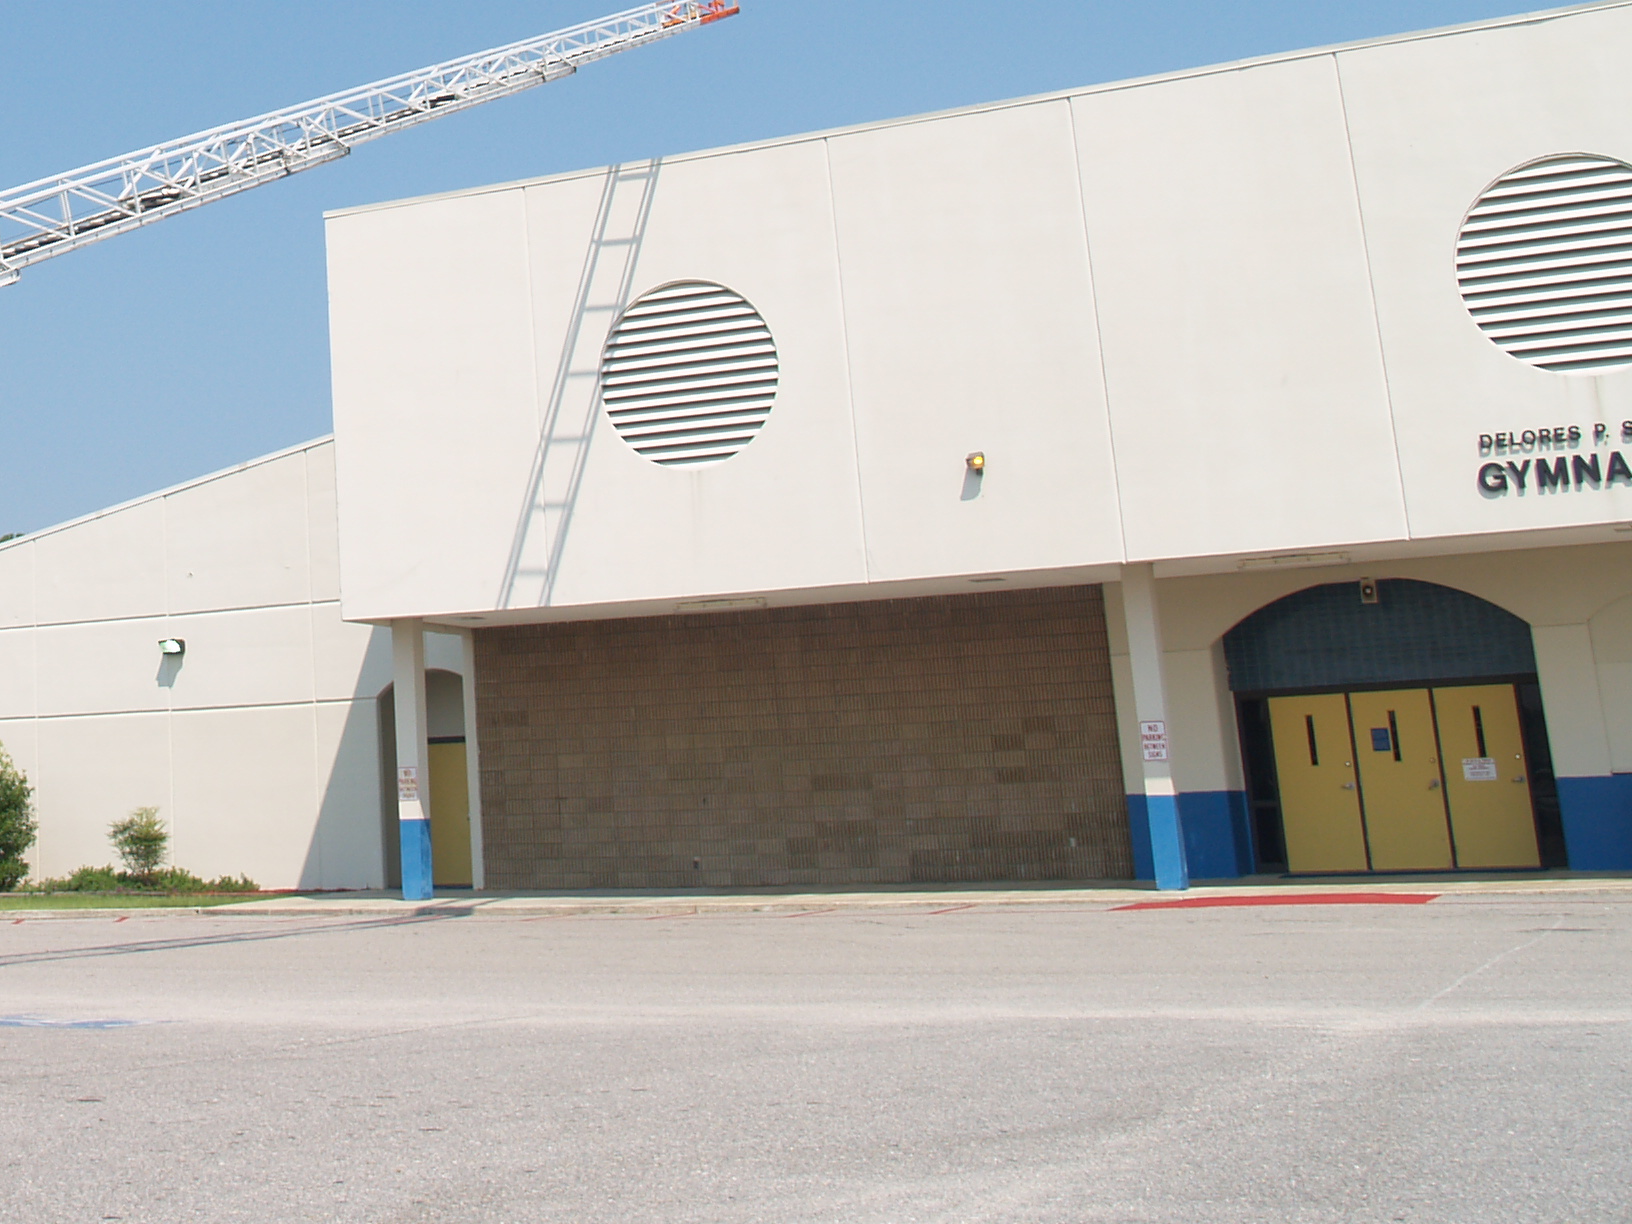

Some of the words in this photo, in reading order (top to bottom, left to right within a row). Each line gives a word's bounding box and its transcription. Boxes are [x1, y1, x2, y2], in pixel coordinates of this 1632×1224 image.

[1479, 425, 1581, 449] DELORES
[1593, 423, 1609, 439] P.
[1478, 451, 1632, 492] GYMNA
[1148, 724, 1158, 732] NO
